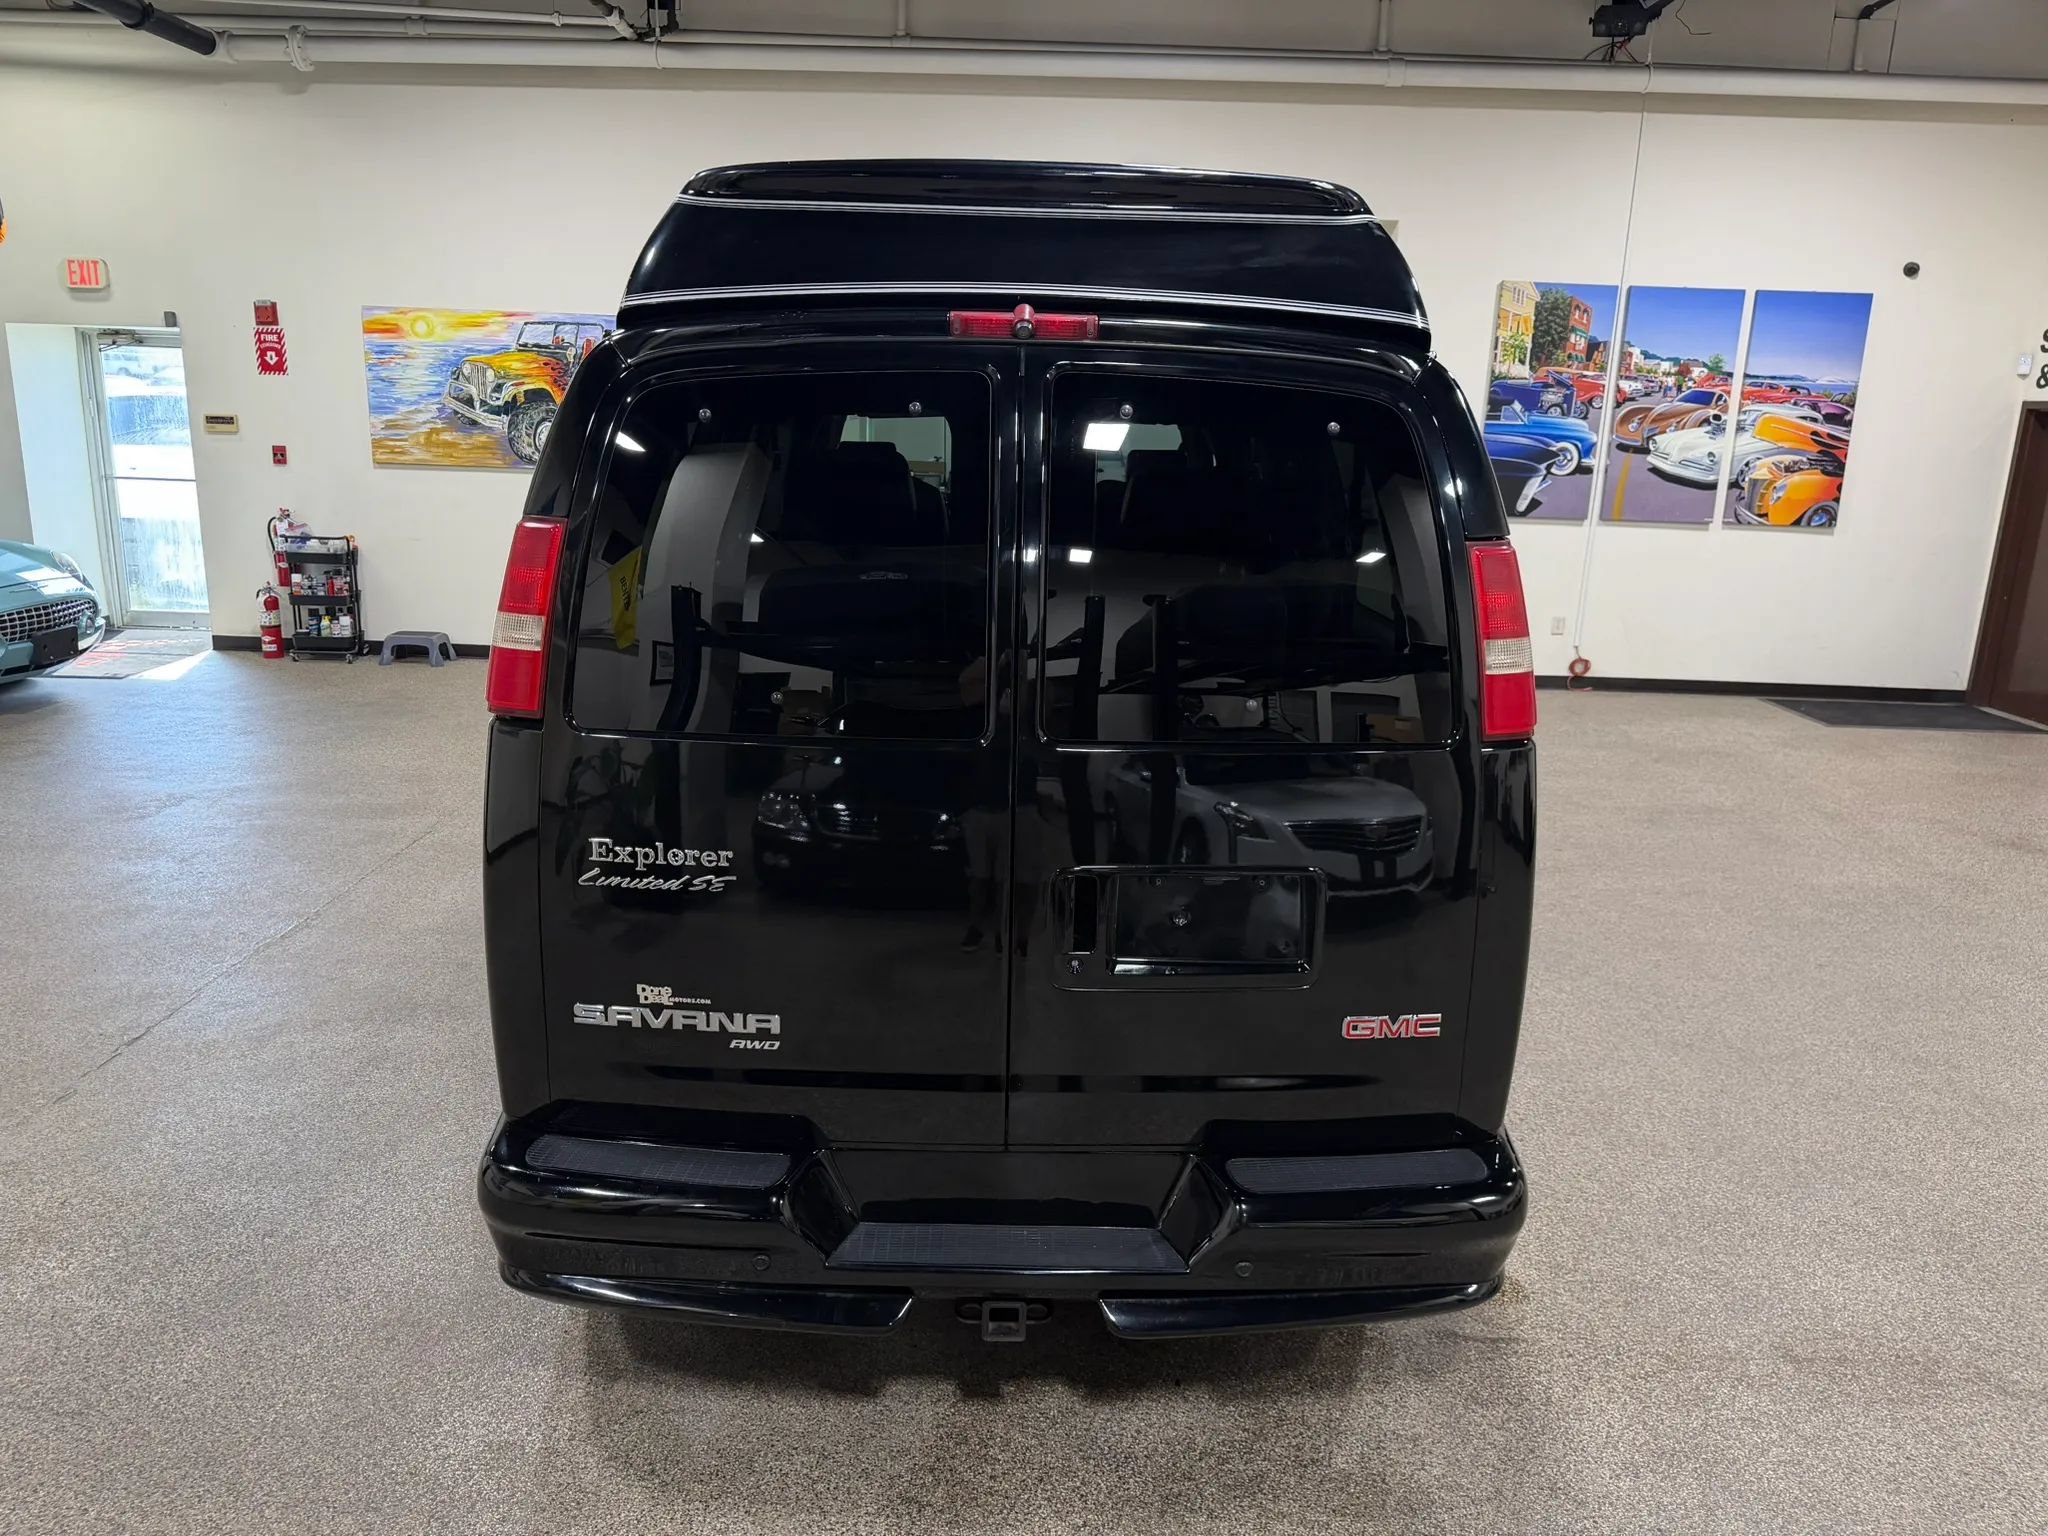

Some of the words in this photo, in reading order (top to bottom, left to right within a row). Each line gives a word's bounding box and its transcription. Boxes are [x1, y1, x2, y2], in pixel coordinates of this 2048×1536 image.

[67, 259, 99, 286] EXIT
[260, 333, 280, 342] FIRE
[588, 837, 734, 871] Explorer
[578, 867, 690, 891] Limited
[688, 875, 737, 892] SE
[636, 984, 672, 997] Done
[573, 1002, 781, 1035] SAVANA
[1342, 1013, 1442, 1039] GMC
[729, 1039, 781, 1050] AWD
